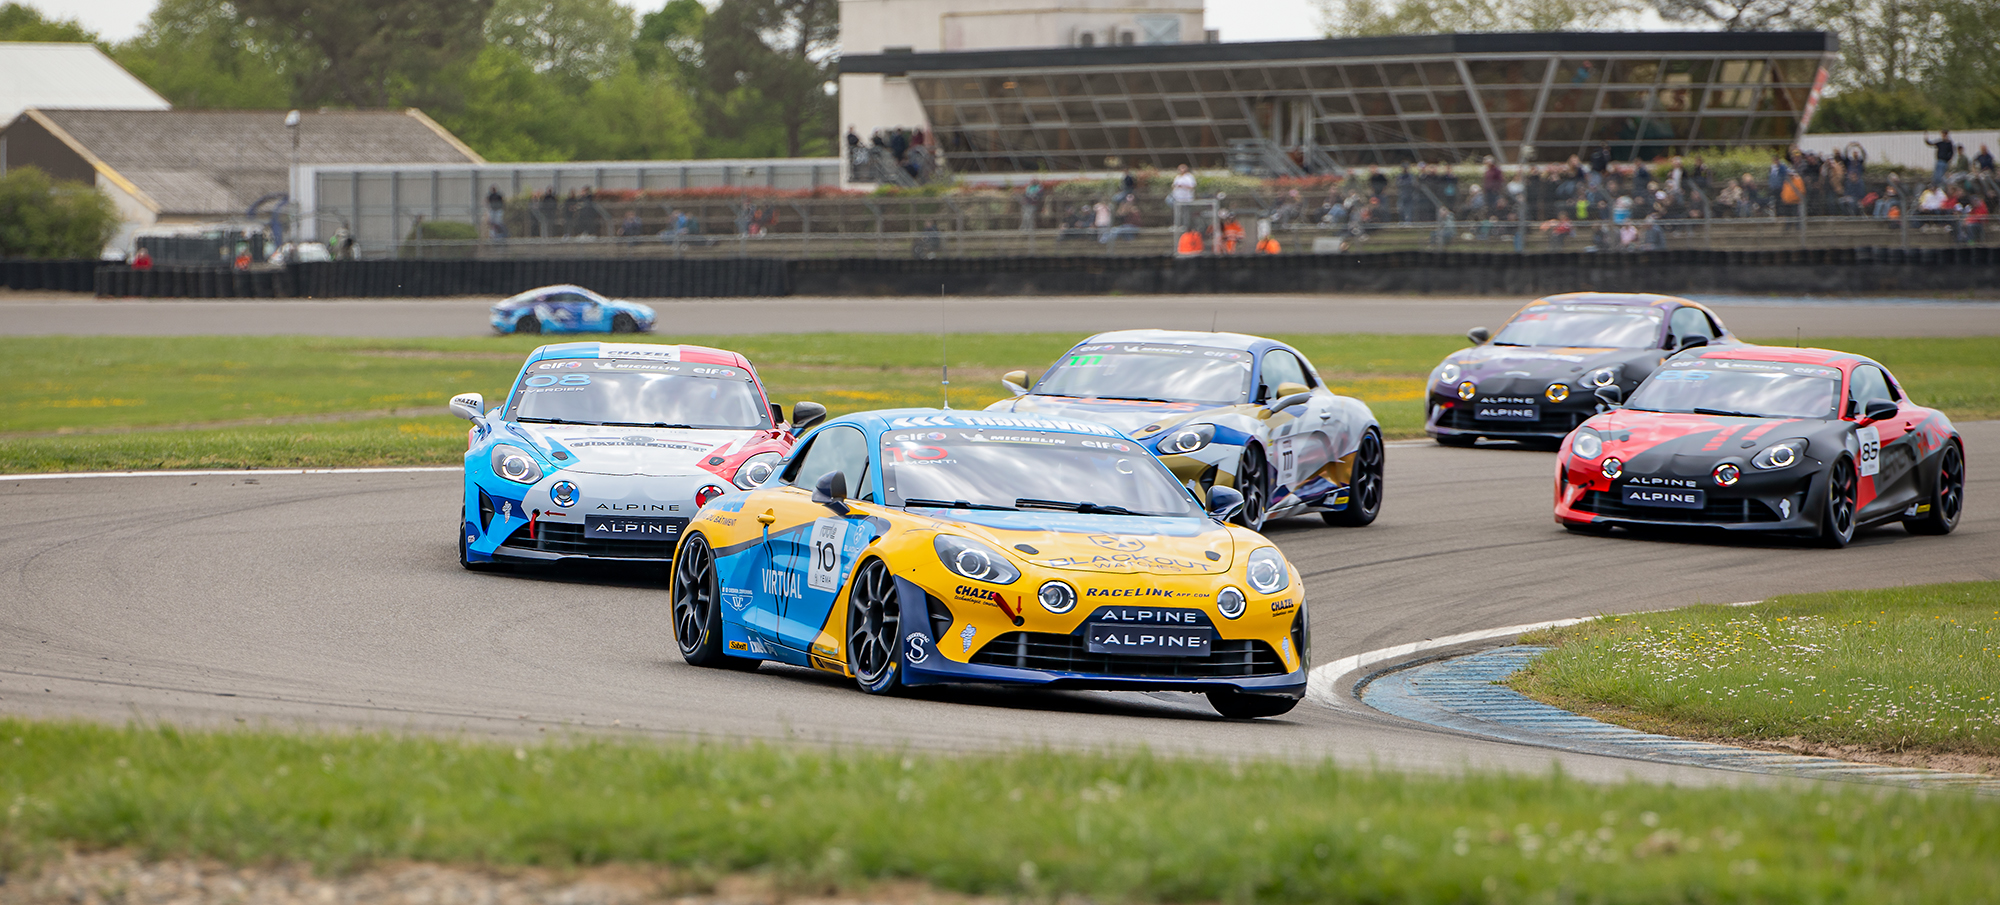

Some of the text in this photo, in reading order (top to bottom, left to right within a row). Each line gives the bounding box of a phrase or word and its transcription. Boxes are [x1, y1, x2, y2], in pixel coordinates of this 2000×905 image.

[538, 361, 566, 370] elf
[616, 363, 680, 371] MICHELIN
[693, 367, 719, 375] elf
[524, 373, 592, 388] 08
[1480, 396, 1535, 405] ALPINE
[1479, 408, 1534, 418] ALPINE
[894, 432, 926, 442] elf
[990, 435, 1066, 444] MICHELIN
[1081, 440, 1112, 450] elf
[1861, 440, 1878, 462] 85
[885, 445, 948, 462] 10
[1629, 476, 1697, 488] ALPINE
[1629, 491, 1696, 503] ALPINE
[596, 502, 680, 512] ALPINE
[595, 523, 678, 534] ALPINE
[815, 540, 836, 573] 10
[1048, 553, 1212, 572] BLACKOUT
[1093, 561, 1182, 572] WATCHES
[761, 568, 802, 600] VIRTUAL
[955, 584, 995, 601] CHAZE
[1271, 598, 1294, 611] CHAZEL
[1101, 609, 1197, 623] ALPINE
[1103, 633, 1201, 648] ALPINE
